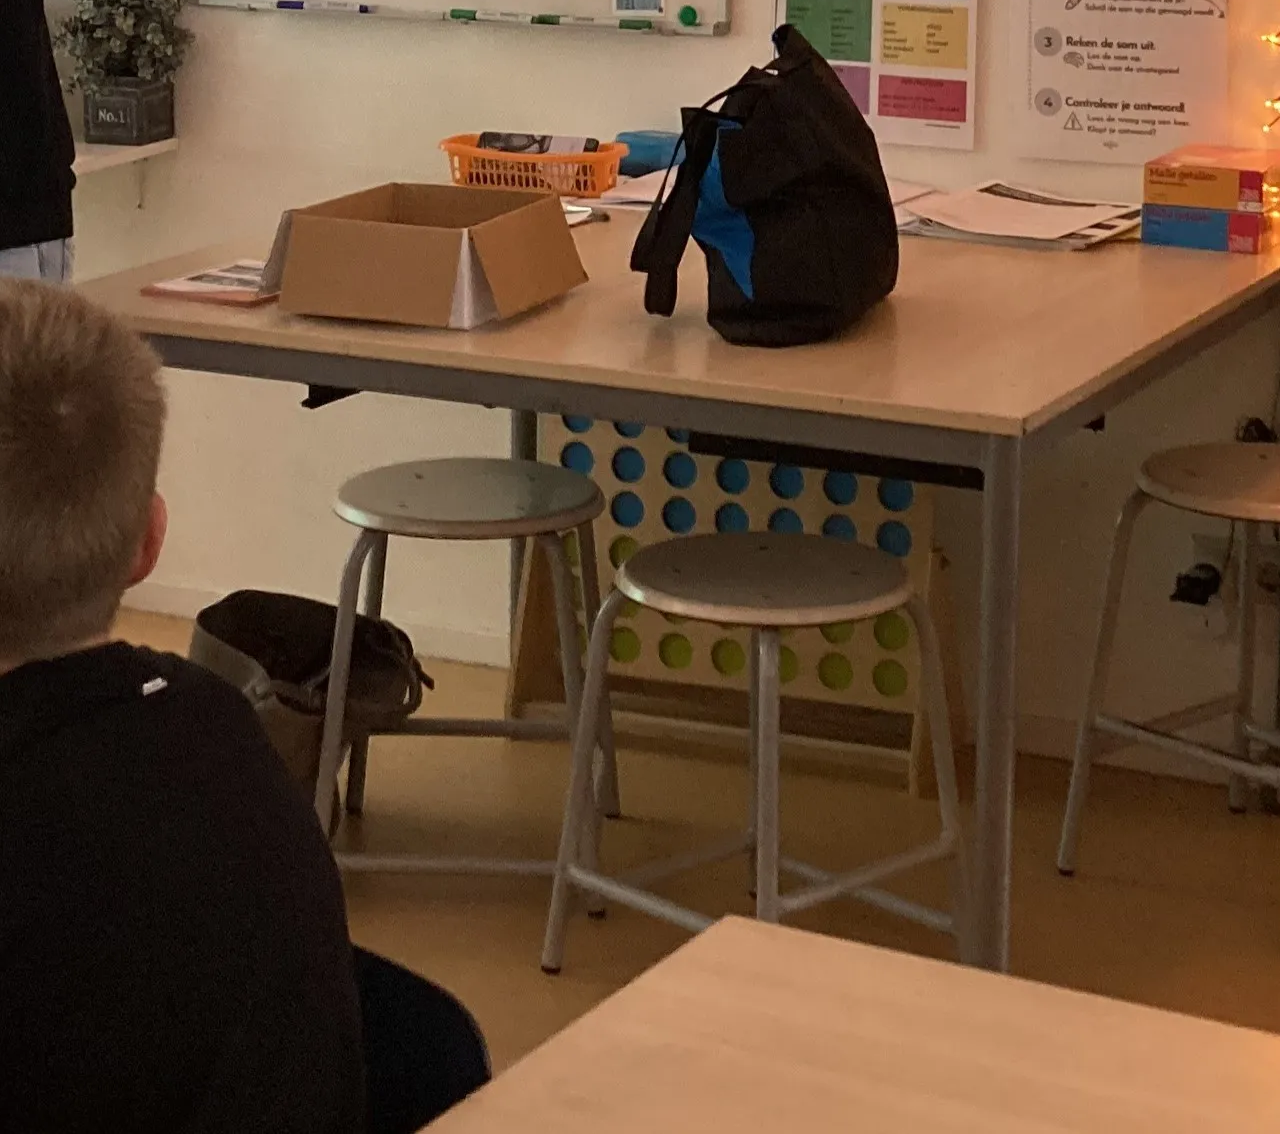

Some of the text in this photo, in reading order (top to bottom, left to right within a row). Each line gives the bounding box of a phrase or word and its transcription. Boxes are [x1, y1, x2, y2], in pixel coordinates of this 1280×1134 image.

[1044, 37, 1053, 47] 3
[1066, 36, 1097, 47] Reken
[1101, 37, 1113, 48] de
[1117, 41, 1137, 49] som
[1043, 97, 1053, 107] 4
[1065, 96, 1119, 109] Controleer
[1121, 100, 1130, 112] je
[98, 108, 125, 123] No.1
